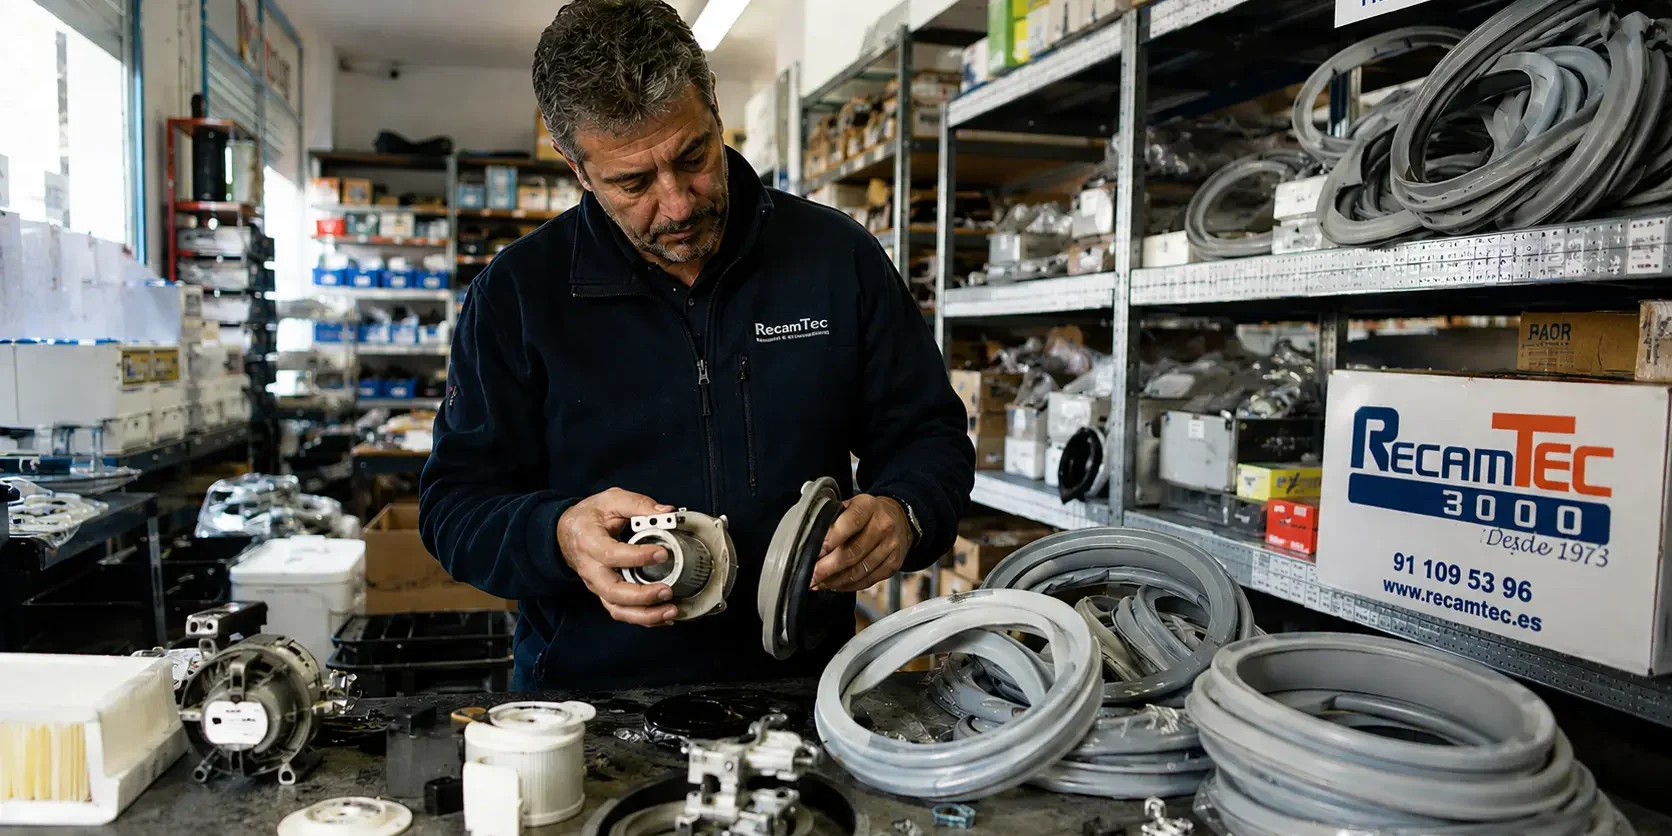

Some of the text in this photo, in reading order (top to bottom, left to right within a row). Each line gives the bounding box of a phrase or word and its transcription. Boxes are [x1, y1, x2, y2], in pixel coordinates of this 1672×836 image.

[755, 318, 828, 336] RecamTec
[1443, 489, 1583, 536] 3000
[1486, 528, 1609, 568] Desde 1973
[1393, 552, 1532, 602] 91 109 53 96
[1383, 578, 1542, 632] www.recamtec.es
